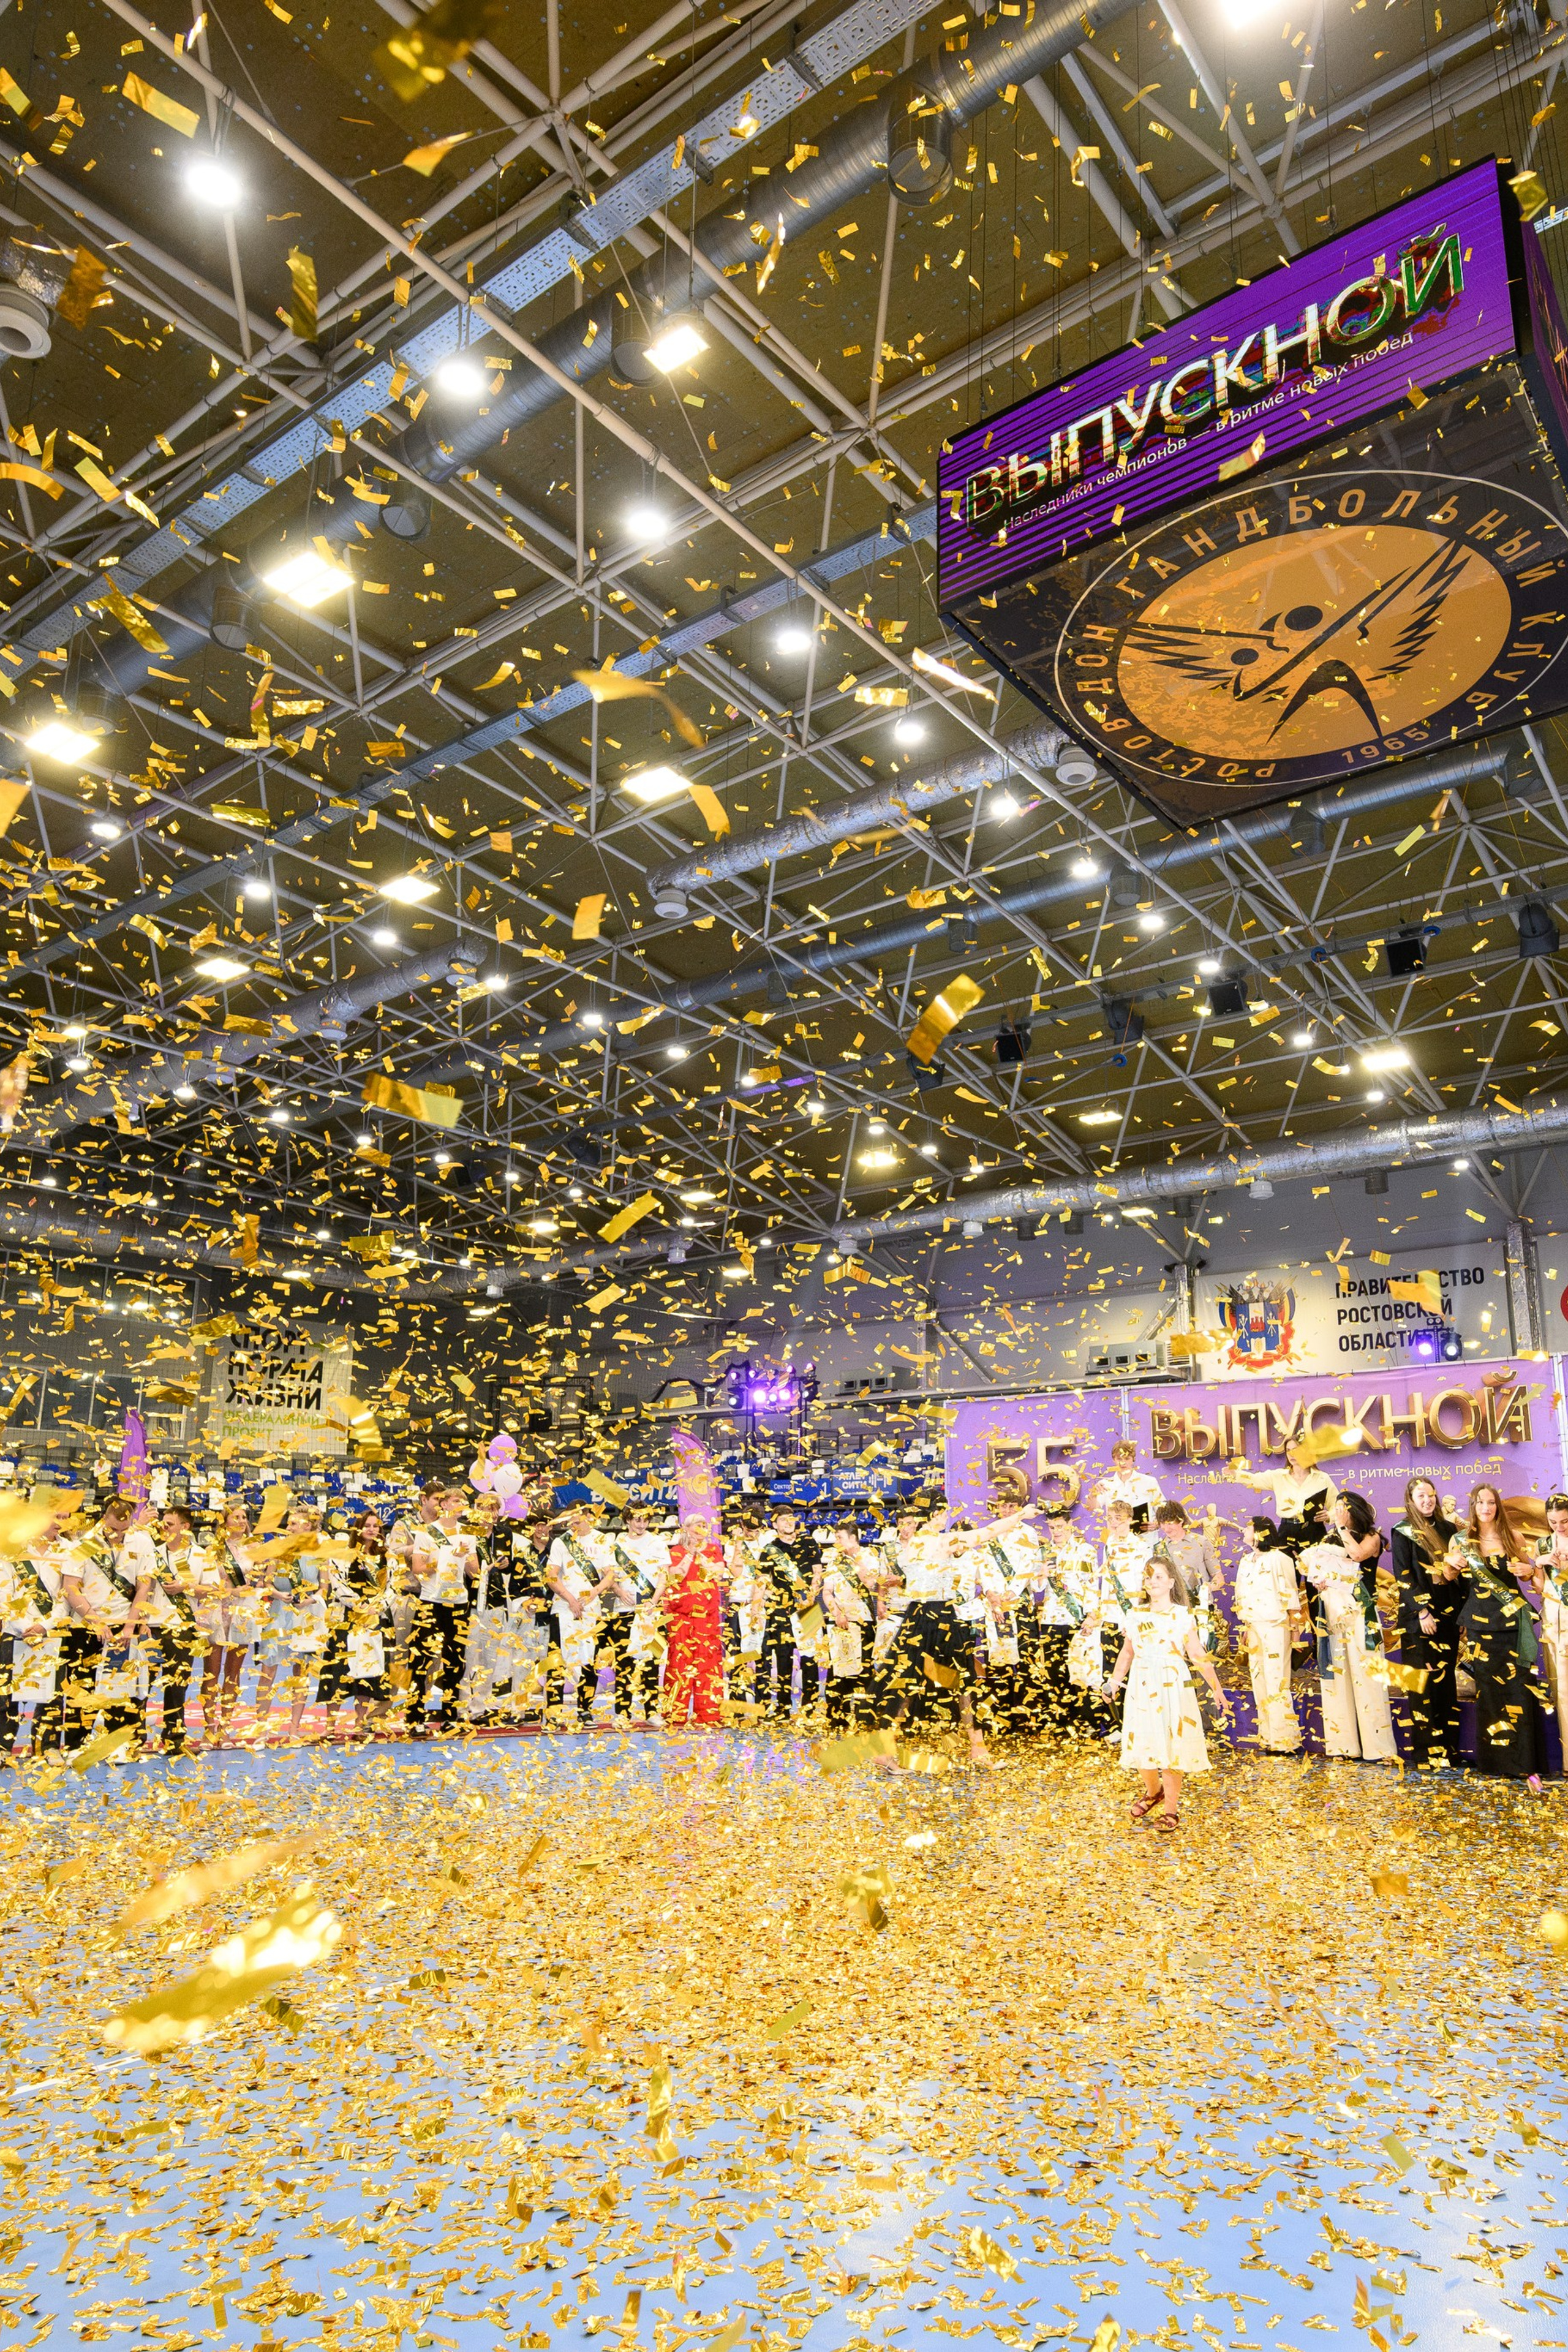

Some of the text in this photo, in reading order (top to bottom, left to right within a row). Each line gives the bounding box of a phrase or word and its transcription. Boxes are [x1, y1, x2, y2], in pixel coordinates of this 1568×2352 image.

[967, 222, 1464, 527] ВЫПУСКНОЙ
[1003, 482, 1093, 532] Наследники
[1096, 438, 1188, 485] чемпионов
[1216, 421, 1225, 432] в
[1231, 391, 1284, 428] ритме
[1291, 361, 1348, 398] новых
[1354, 331, 1413, 368] побед
[1115, 489, 1566, 598] ГАНДБОЛЬНЫЙ
[1466, 611, 1557, 704] КЛУБ
[1341, 727, 1430, 764] 1965
[1335, 1267, 1485, 1298] ПРАВИТСТВО
[1337, 1294, 1452, 1325] РОСТОВСКЙ
[228, 1351, 323, 1384] НОРМА
[225, 1379, 322, 1410] ЖИЗНИ
[1150, 1370, 1533, 1459] ВЫПУСКНОЙ
[987, 1436, 1081, 1510] 55
[1349, 1469, 1355, 1479] в
[1360, 1467, 1403, 1482] ритме
[1407, 1465, 1451, 1477] новых
[1456, 1461, 1502, 1475] побед
[821, 1482, 827, 1496] 1
[377, 1506, 391, 1521] 12
